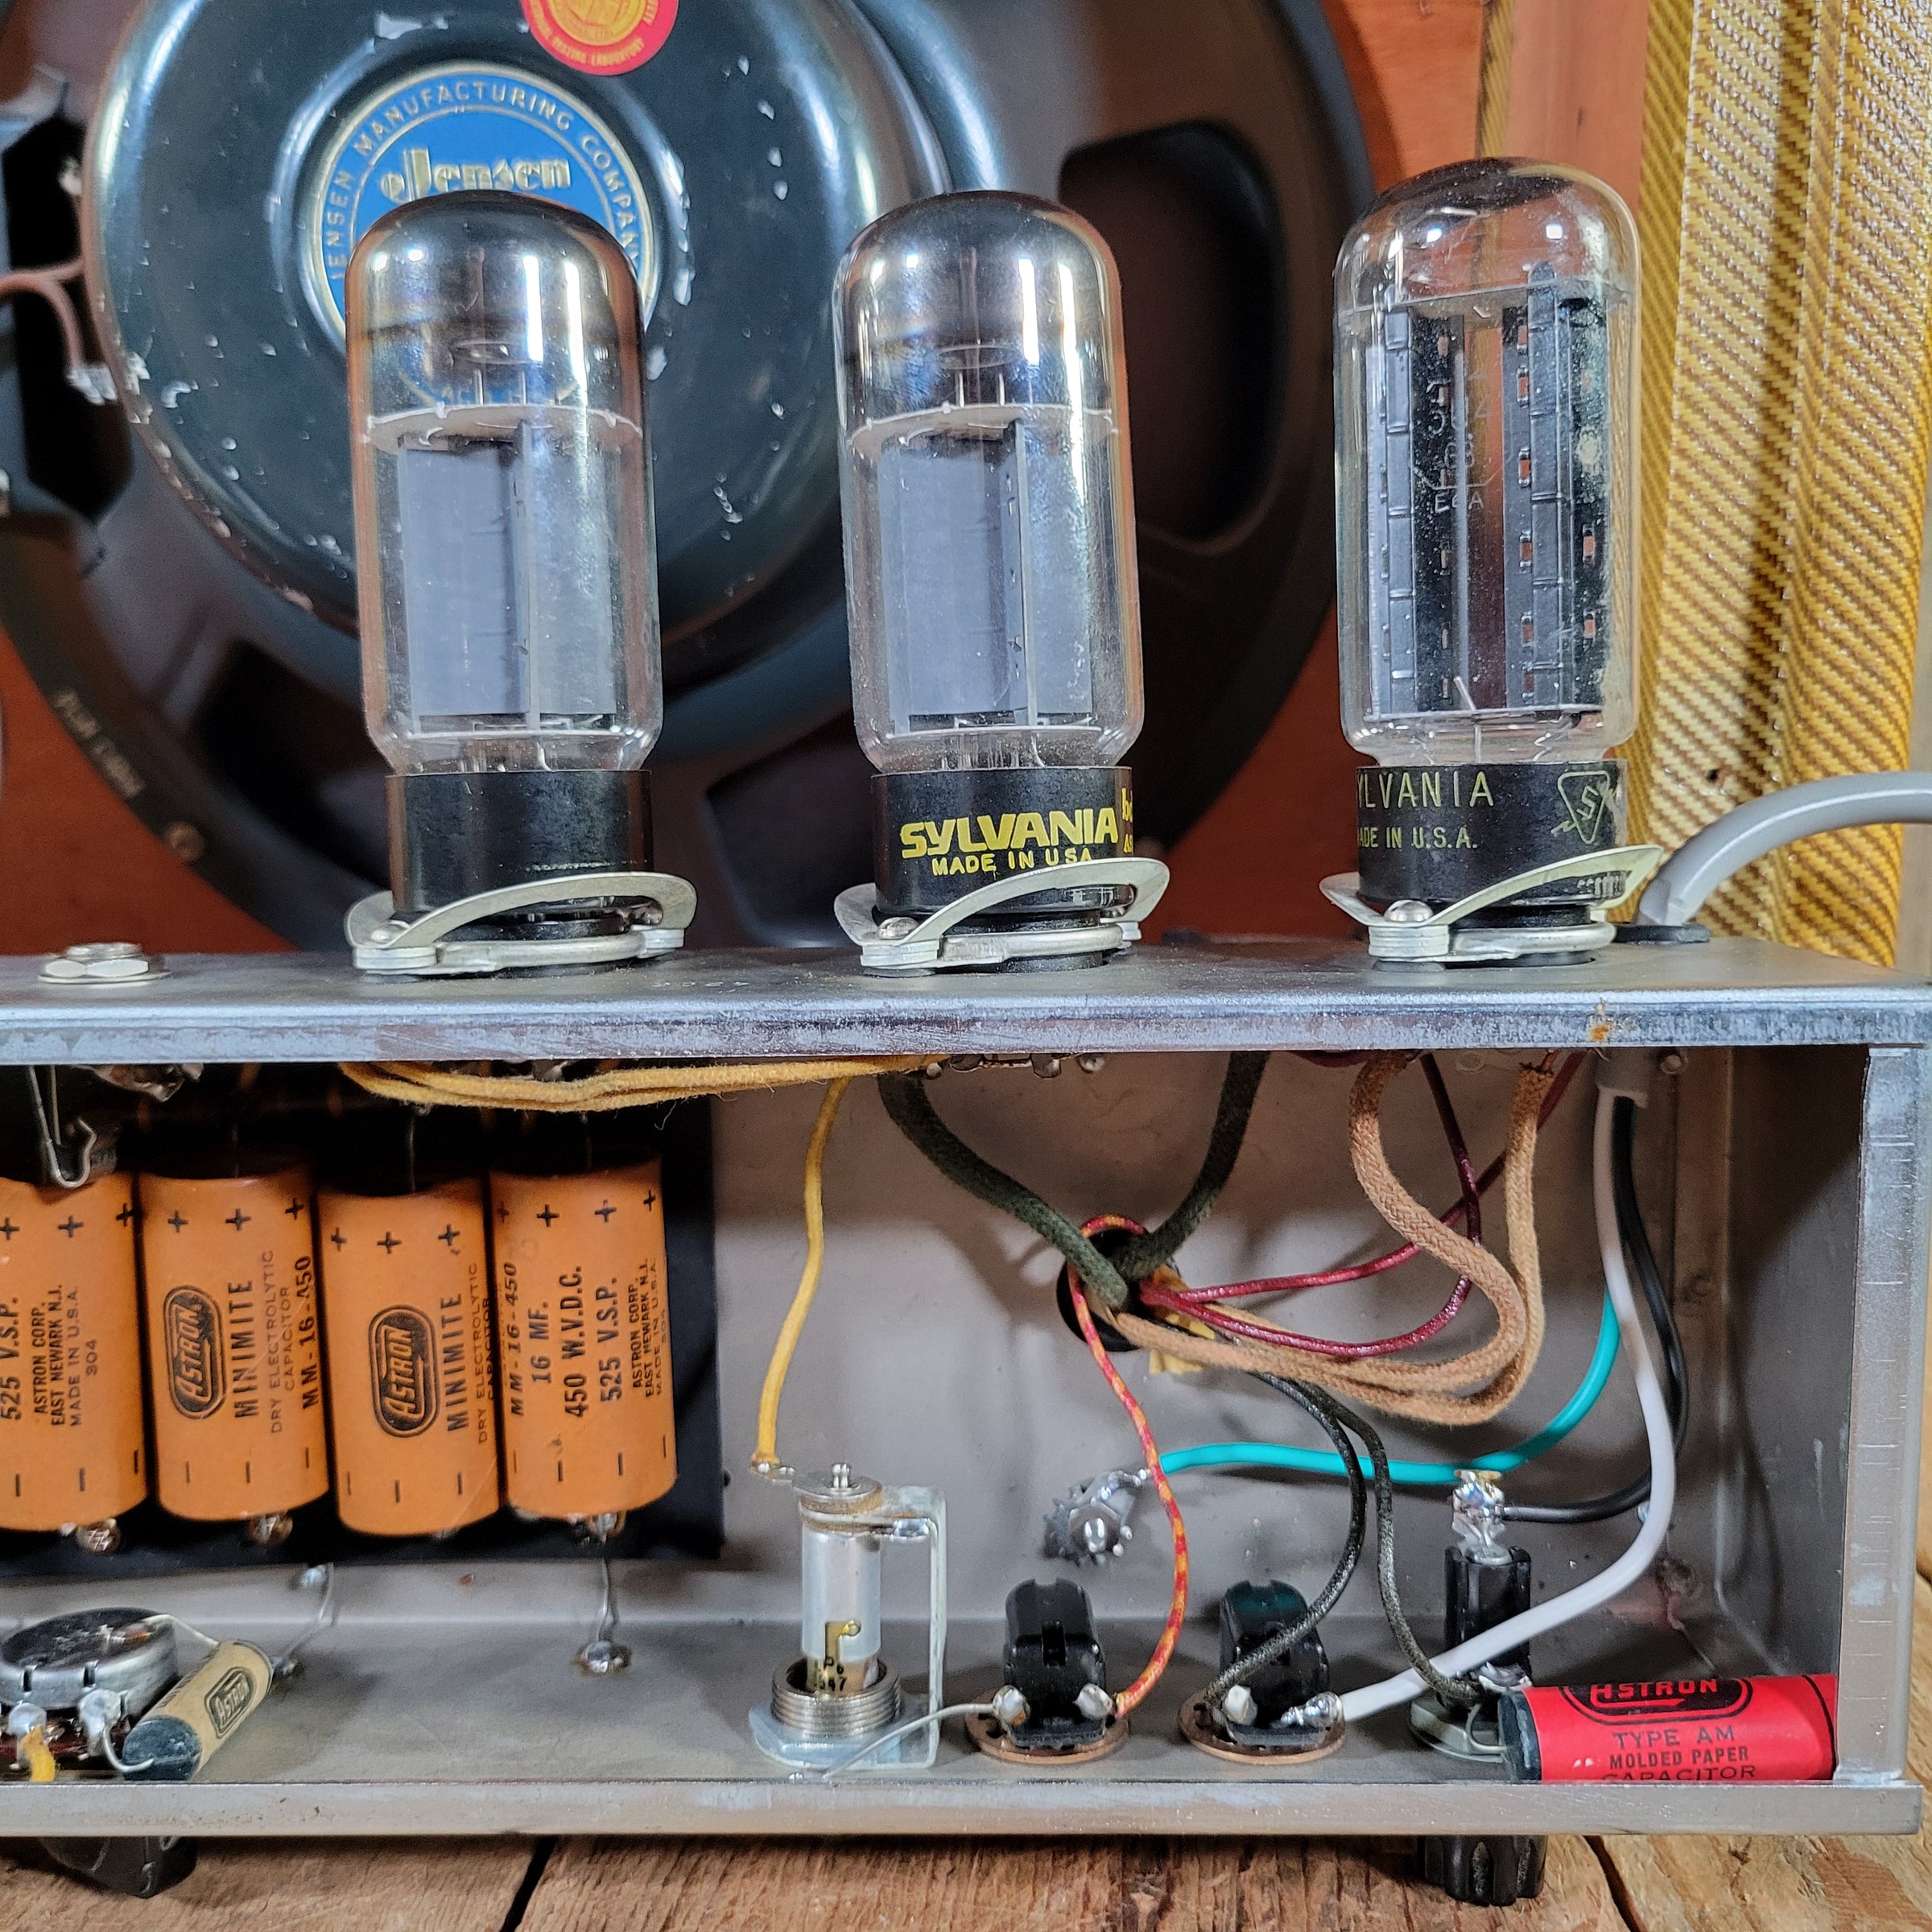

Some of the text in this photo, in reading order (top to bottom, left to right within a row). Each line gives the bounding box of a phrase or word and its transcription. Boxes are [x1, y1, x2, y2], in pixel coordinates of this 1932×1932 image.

[353, 81, 573, 158] MANUFACTURING
[380, 147, 572, 205] Jensen
[900, 807, 1119, 859] SYLVANIA
[931, 853, 997, 876] MADE
[1008, 850, 1035, 869] IN
[1386, 826, 1402, 848] IN
[1412, 826, 1478, 849] U.S.A.
[48, 1319, 64, 1382] NEWARK
[173, 1298, 213, 1404] ASTRON
[228, 1280, 259, 1418] MINIMITE
[262, 1249, 283, 1434] DRY ELECTROLYTIC
[280, 1286, 295, 1392] CAPACITOR
[468, 1262, 488, 1444] DRY ELECTROLYTIC
[527, 1301, 552, 1385] 16 MF.
[559, 1265, 588, 1418] 450 W.V.D.C.
[595, 1277, 623, 1402] 525 V.S.P.
[627, 1278, 644, 1389] ASTRON CORP.
[640, 1292, 652, 1355] NEWARK
[652, 1318, 660, 1338] IN
[0, 1297, 21, 1421] 525 V.S.P.
[31, 1302, 47, 1414] ASTRON CORP.
[68, 1347, 80, 1366] IN
[380, 1324, 425, 1419] ASTRON
[440, 1293, 469, 1431] MINIMITE
[644, 1362, 655, 1398] EAST
[654, 1344, 663, 1397] MADE
[51, 1389, 65, 1426] EAST
[68, 1375, 81, 1426] MADE
[1591, 1678, 1718, 1707] ASTRON
[1609, 1745, 1749, 1770] MOLDED PAPER
[1612, 1725, 1735, 1750] TYPE AM
